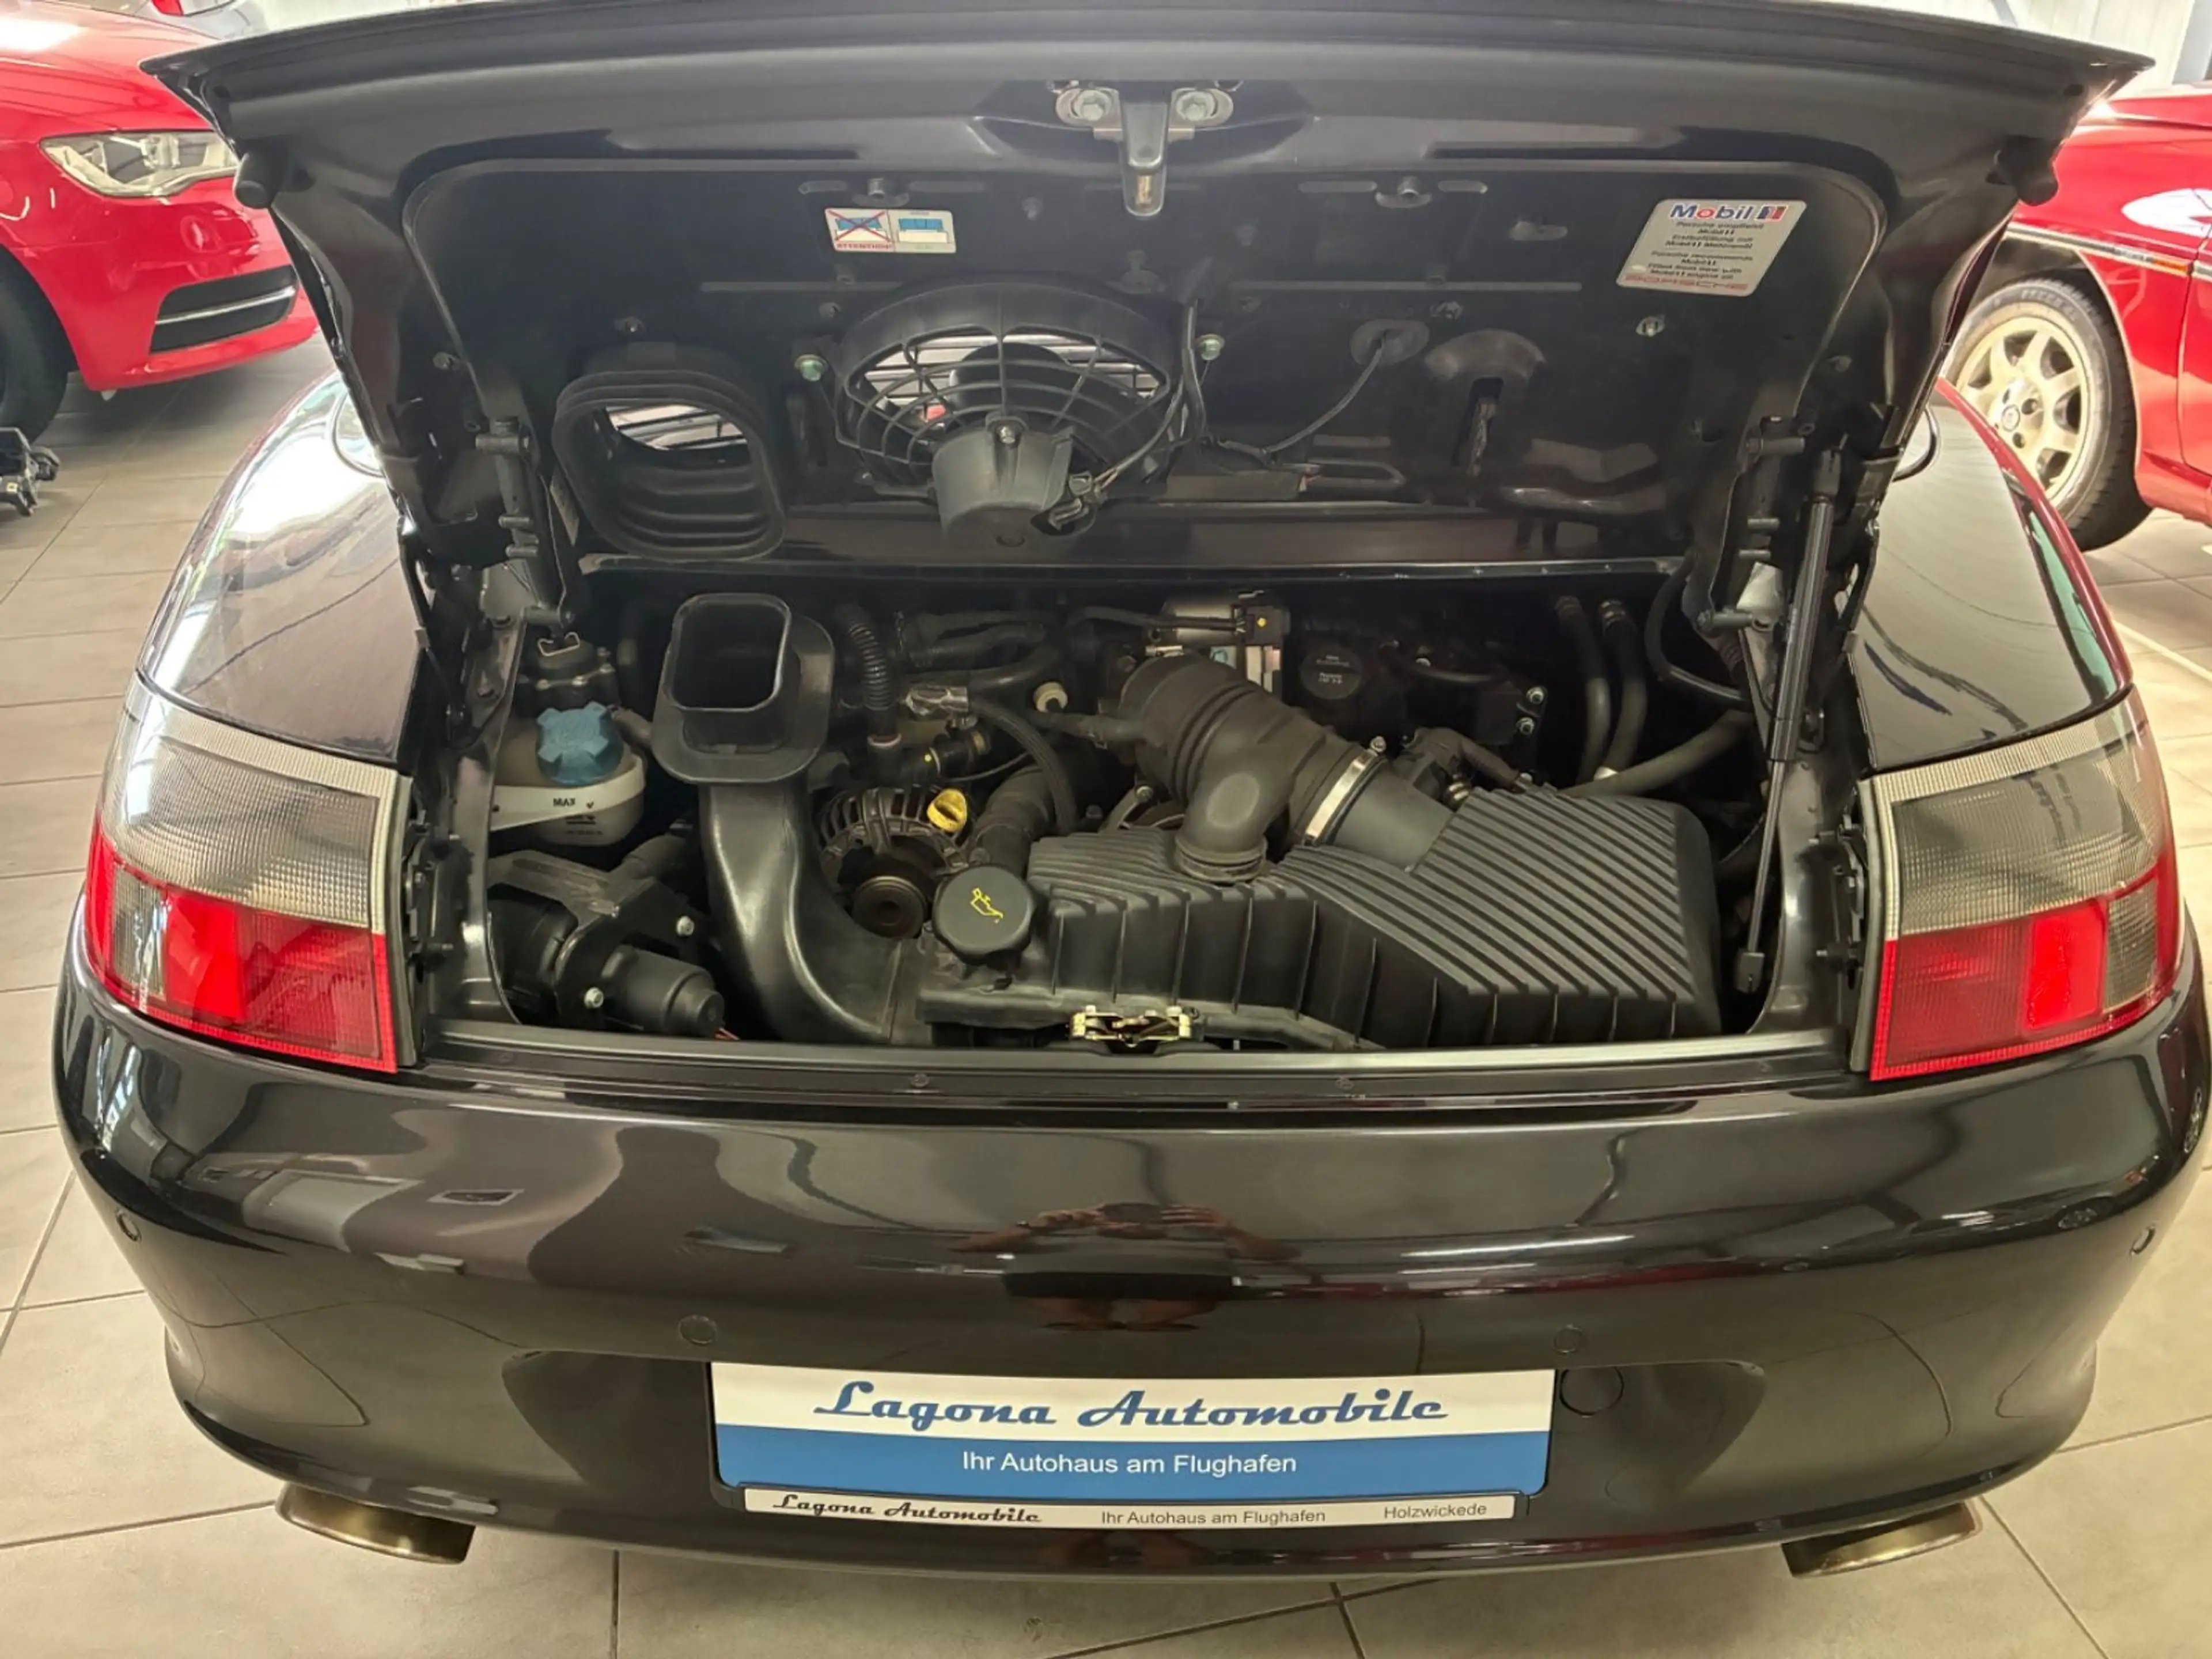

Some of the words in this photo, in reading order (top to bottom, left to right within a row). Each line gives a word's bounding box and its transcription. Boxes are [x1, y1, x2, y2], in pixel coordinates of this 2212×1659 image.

[1671, 204, 1754, 220] Mobil
[553, 797, 575, 807] MAX
[813, 1381, 1056, 1431] Lagona
[1077, 1388, 1449, 1426] Automobile
[962, 1451, 995, 1470] Ihr
[1001, 1453, 1118, 1474] Autohaus
[1126, 1459, 1165, 1474] am
[1173, 1455, 1296, 1479] Flughafen
[772, 1494, 874, 1516] Lagona
[884, 1501, 1042, 1524] Automobile
[1101, 1511, 1124, 1524] Ihr
[1129, 1511, 1206, 1525] Autohaus
[1211, 1514, 1238, 1524] am
[1243, 1510, 1326, 1525] Flughafen
[1384, 1503, 1488, 1520] Holzwickede
